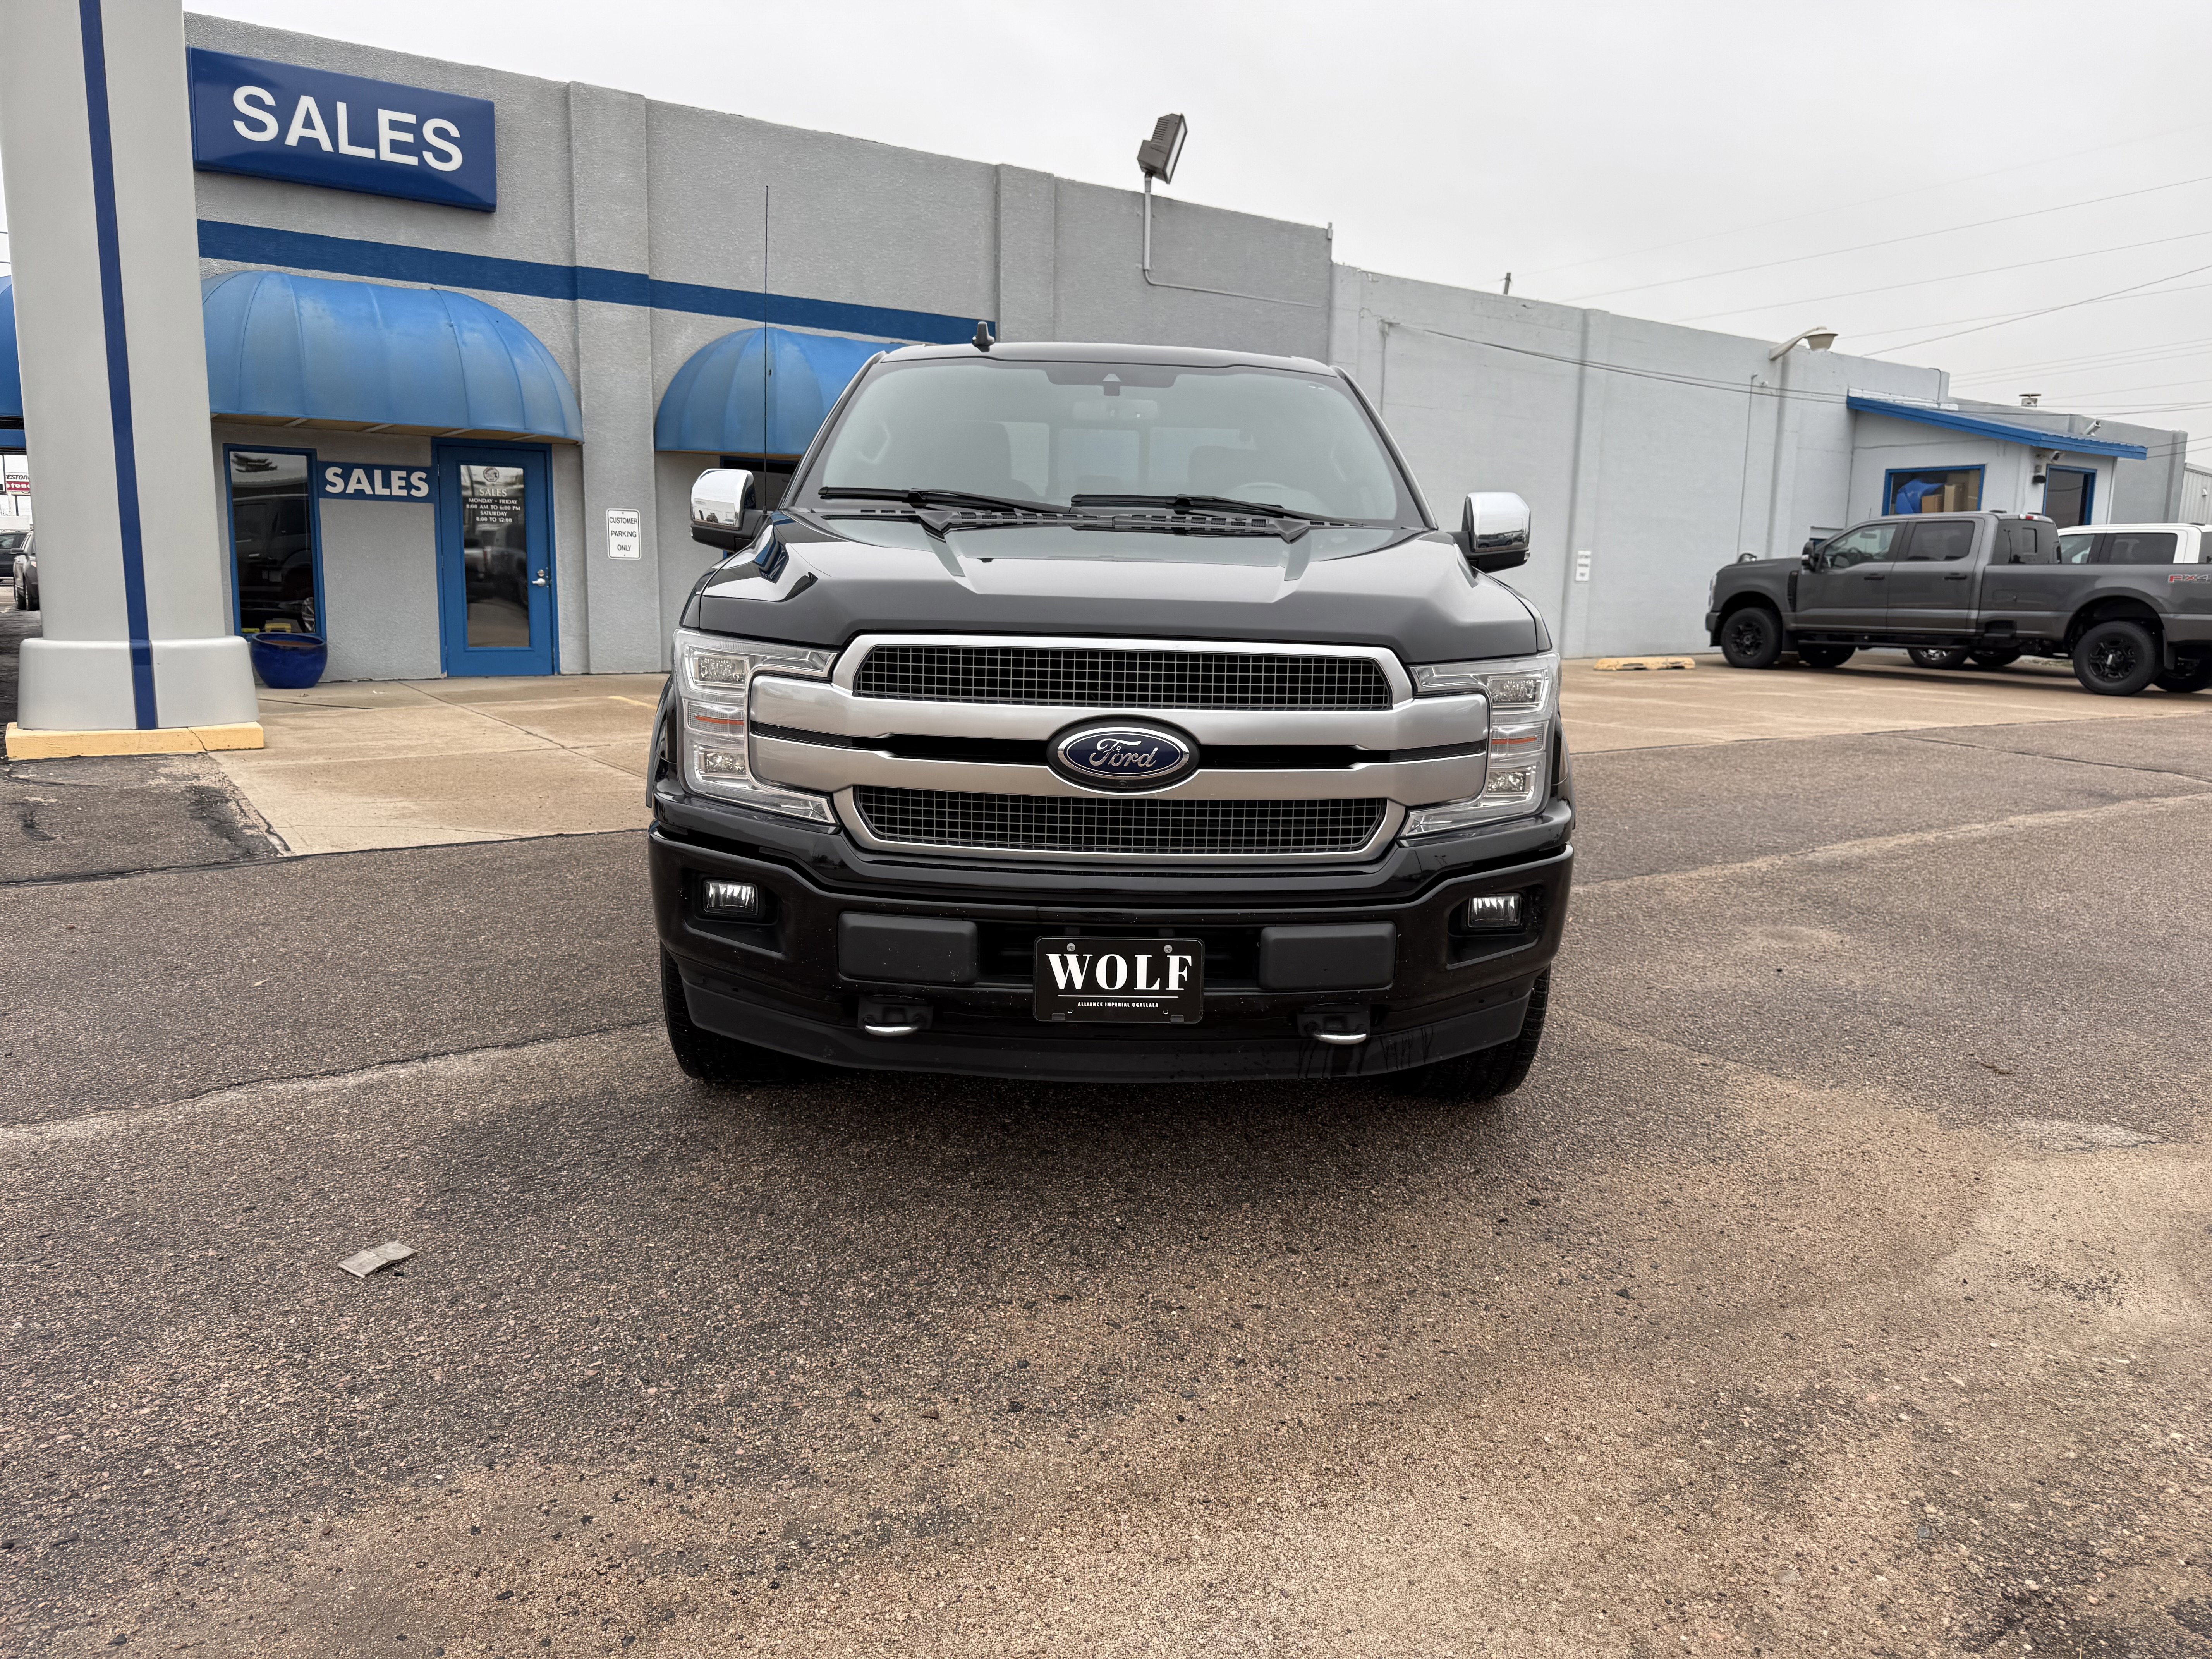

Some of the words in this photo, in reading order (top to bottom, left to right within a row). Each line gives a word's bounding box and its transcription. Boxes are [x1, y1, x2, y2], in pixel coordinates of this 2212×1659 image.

[232, 86, 463, 172] SALES
[325, 466, 429, 497] SALES
[479, 488, 507, 497] SALES
[2168, 574, 2211, 583] FX4
[1089, 738, 1159, 768] Ford
[1046, 953, 1192, 991] WOLF
